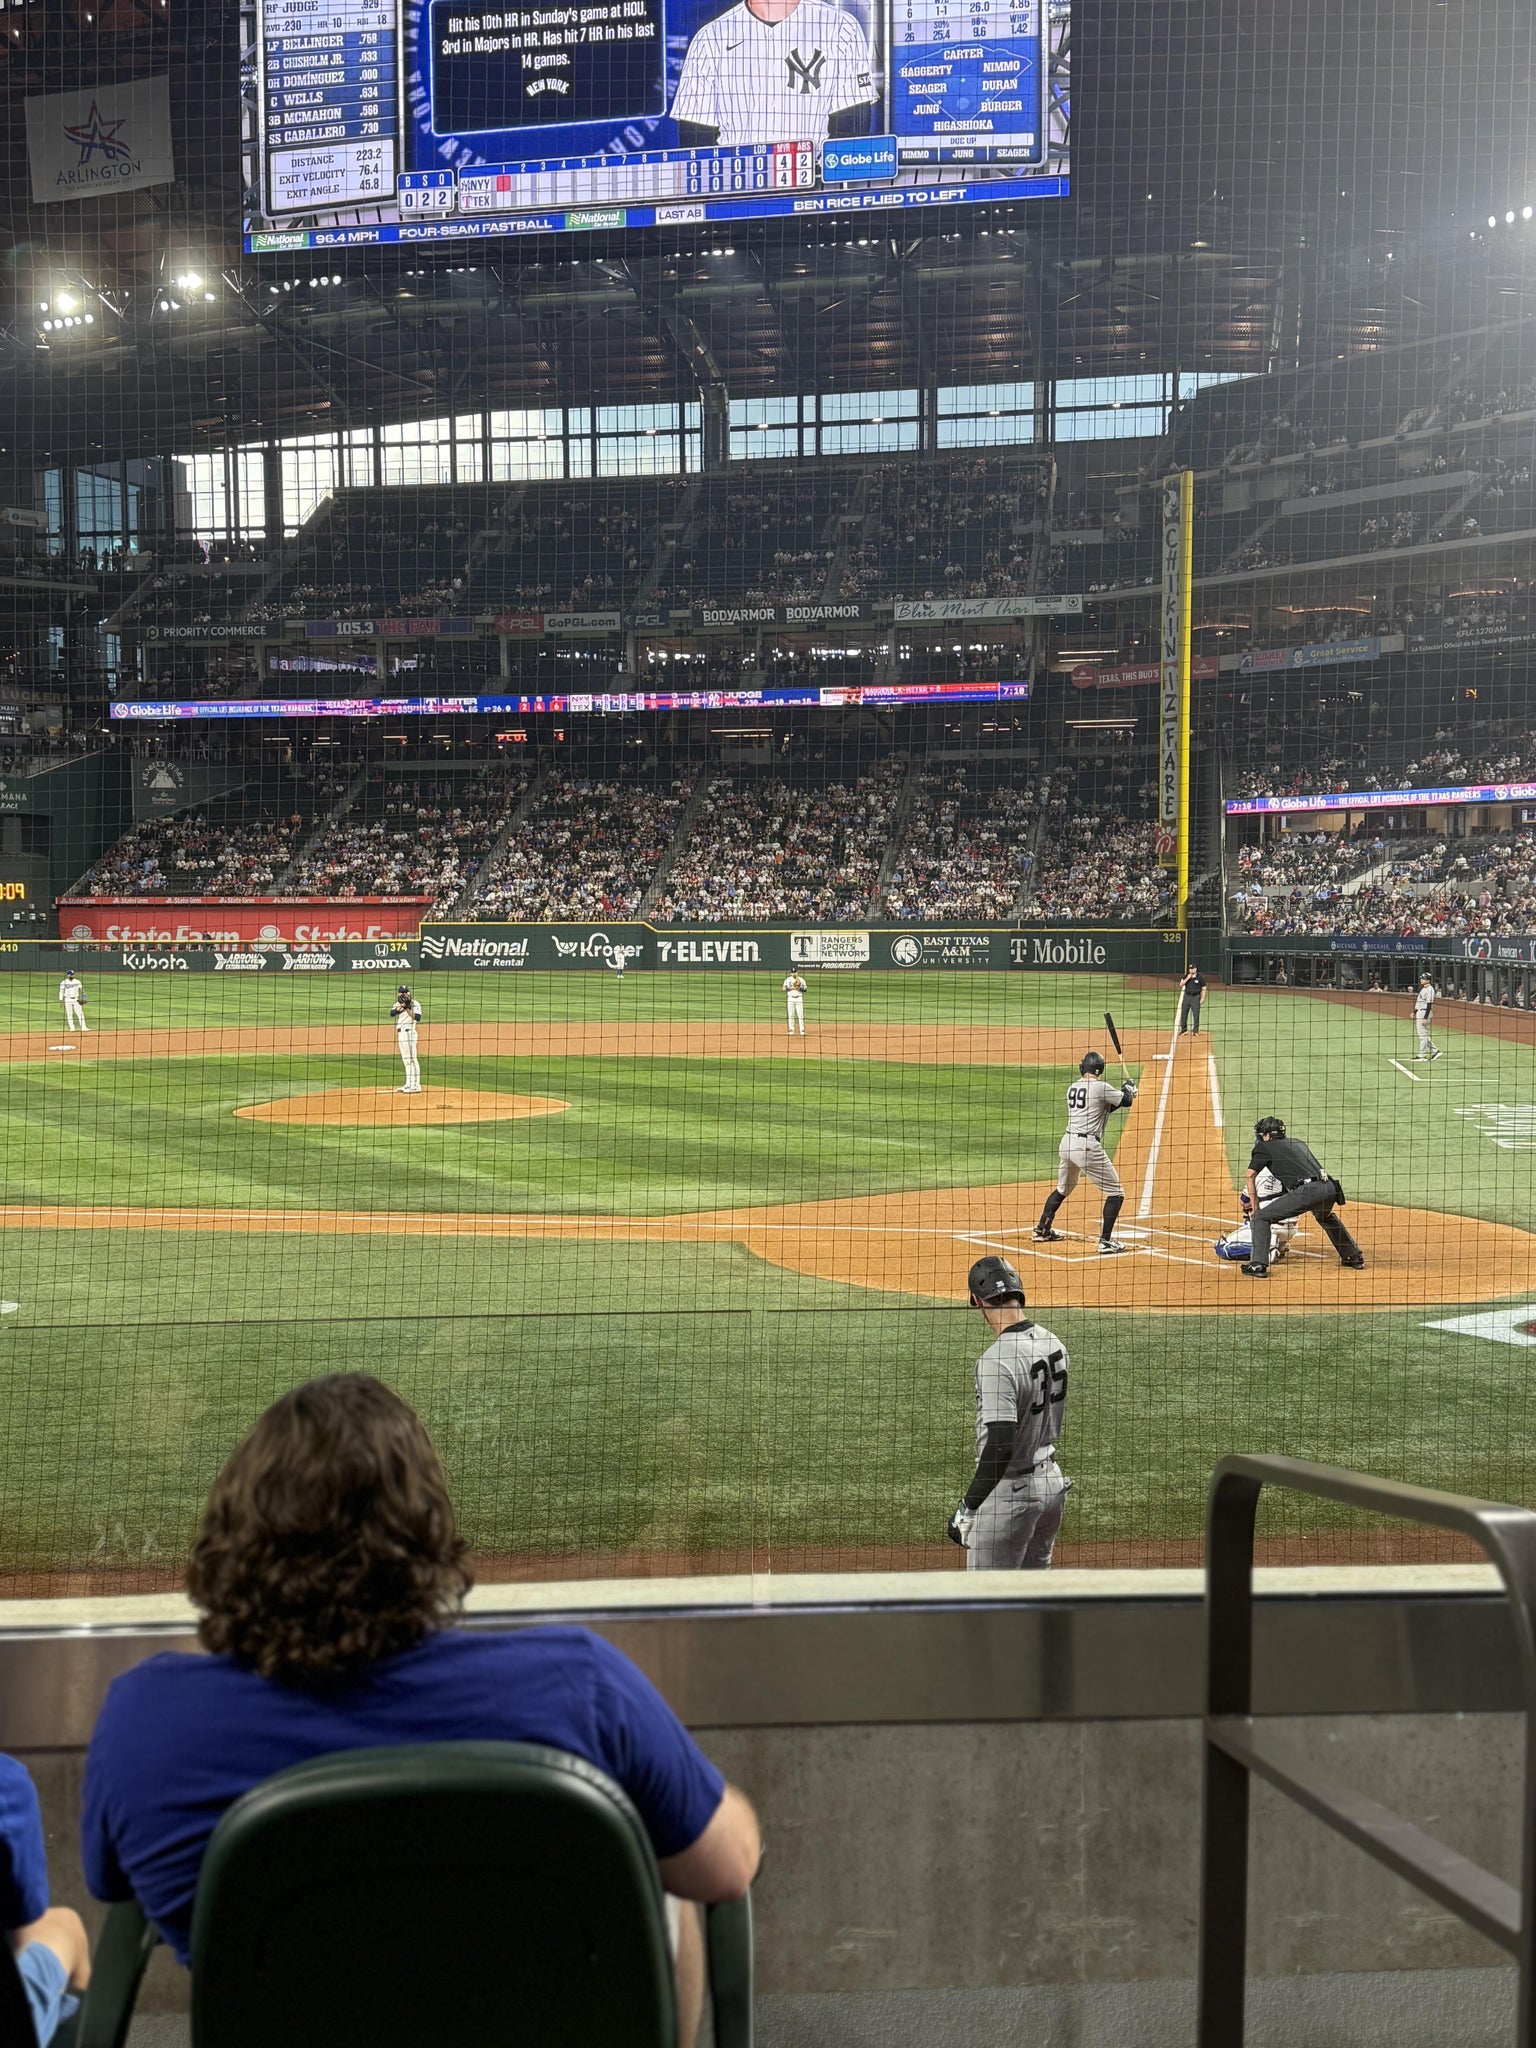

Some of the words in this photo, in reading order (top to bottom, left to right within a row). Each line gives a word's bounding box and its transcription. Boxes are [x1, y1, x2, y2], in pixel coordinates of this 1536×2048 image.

[266, 4, 278, 13] RF
[283, 1, 318, 13] JUDGE
[361, 0, 379, 9] .929
[969, 3, 990, 13] 26.0
[282, 20, 302, 32] .230
[333, 18, 342, 28] 10
[377, 15, 387, 24] 18
[448, 18, 463, 33] Hit
[465, 17, 480, 31] his
[482, 15, 502, 29] 10th
[504, 13, 518, 27] HR
[520, 12, 531, 26] in
[533, 8, 578, 26] Sunday's
[580, 8, 608, 24] game
[611, 6, 621, 17] at
[1010, 13, 1030, 23] WHIP
[933, 29, 950, 40] 25.4
[973, 27, 987, 37] 9.6
[1011, 23, 1028, 34] 1.42
[267, 41, 279, 52] LF
[283, 35, 344, 50] BELLINGER
[442, 38, 460, 54] 3rd
[463, 37, 472, 52] in
[474, 34, 510, 53] Majors
[512, 33, 522, 48] in
[524, 31, 541, 46] HR.
[543, 30, 562, 45] Has
[564, 28, 578, 43] hit
[580, 27, 587, 41] 7
[589, 25, 603, 40] HR
[605, 25, 615, 39] in
[617, 23, 633, 38] his
[635, 22, 655, 37] last
[267, 60, 280, 70] 2B
[283, 55, 328, 69] CHISHOLM
[330, 53, 345, 65] JR.
[522, 54, 532, 67] 14
[534, 53, 570, 69] games.
[944, 48, 984, 61] CARTER
[901, 64, 953, 78] HAGGERTY
[983, 60, 1020, 73] NIMMO
[267, 78, 280, 89] DH
[283, 71, 345, 87] DOMÍNGUEZ
[360, 69, 377, 80] .000
[526, 79, 546, 97] NEW
[909, 83, 947, 95] SEAGER
[982, 79, 1018, 91] DURAN
[284, 91, 323, 105] WELLS
[360, 87, 378, 98] .634
[913, 104, 940, 115] JUNG
[981, 100, 1022, 112] BURGER
[269, 115, 281, 126] 3B
[284, 108, 342, 124] MCMAHON
[933, 119, 994, 132] HIGASHIOKA
[269, 133, 281, 144] SS
[284, 125, 346, 143] CABALLERO
[360, 122, 379, 134] .730
[754, 145, 767, 155] LOB
[797, 141, 811, 151] ABS
[950, 137, 964, 145] DUE
[291, 155, 334, 168] DISTANCE
[356, 148, 381, 162] 223.2
[840, 154, 872, 166] Globe
[874, 152, 894, 163] Life
[902, 150, 929, 159] NIMMO
[952, 149, 974, 158] JUNG
[997, 149, 1030, 157] SEAGER
[56, 160, 141, 185] ARLINGTON
[279, 173, 300, 185] EXIT
[302, 169, 346, 183] VELOCITY
[359, 163, 379, 176] 76.4
[469, 179, 490, 191] NYY
[780, 155, 787, 168] 4
[287, 188, 308, 200] EXIT
[310, 185, 340, 197] ANGLE
[359, 179, 379, 191] 45.8
[474, 195, 490, 206] TEX
[780, 172, 787, 185] 4
[422, 193, 429, 206] 2
[439, 191, 446, 204] 2
[794, 199, 824, 211] BEN
[828, 197, 860, 208] RICE
[863, 195, 904, 206] FLIED
[907, 192, 928, 203] TO
[930, 190, 967, 201] LEFT
[581, 211, 620, 225] National
[659, 209, 685, 220] LAST
[687, 208, 702, 218] AB
[399, 224, 480, 238] FOUR-SEAM
[483, 219, 553, 232] FASTBALL
[264, 233, 305, 245] National
[315, 233, 347, 244] 96.4
[349, 231, 379, 242] MPH
[1164, 527, 1179, 659] CHIKIN
[703, 608, 775, 622] BODYARMOR
[786, 606, 860, 620] BODYARMOR
[898, 603, 937, 619] Blue
[940, 601, 989, 616] Mint
[994, 599, 1031, 615] Thai
[510, 618, 541, 630] PGL
[548, 617, 616, 629] GoPGL.com
[635, 615, 665, 626] PGL
[163, 626, 208, 638] PRIORITY
[211, 625, 266, 637] COMMERCE
[337, 622, 373, 635] 105.3
[377, 621, 406, 634] THE
[1476, 627, 1493, 635] 1270
[1494, 625, 1507, 633] AM
[1310, 650, 1334, 658] Great
[1336, 645, 1369, 655] Service
[1099, 673, 1121, 684] TEXAS,
[1122, 670, 1138, 680] THIS
[1138, 669, 1159, 679] BUD'S
[724, 691, 762, 699] JUDGE
[1003, 687, 1024, 695] 7:10
[163, 704, 182, 715] Life
[1163, 726, 1176, 816] FARE
[1281, 798, 1307, 809] Globe
[1309, 797, 1326, 807] Life
[0, 883, 25, 900] :09
[390, 943, 407, 951] 374
[821, 936, 863, 944] RANGERS
[923, 936, 950, 946] EAST
[954, 936, 989, 946] TEXAS
[1, 944, 18, 952] 410
[446, 938, 529, 957] National
[657, 941, 761, 962] 7-ELEVEN
[941, 946, 971, 956] A&M
[1034, 938, 1106, 965] Mobile
[123, 953, 188, 970] Kubota
[227, 953, 261, 964] ARROW
[352, 959, 411, 969] HONDA
[474, 958, 490, 967] Car
[493, 957, 524, 967] Rental
[1068, 1088, 1087, 1109] 99
[1029, 1349, 1068, 1416] 35
